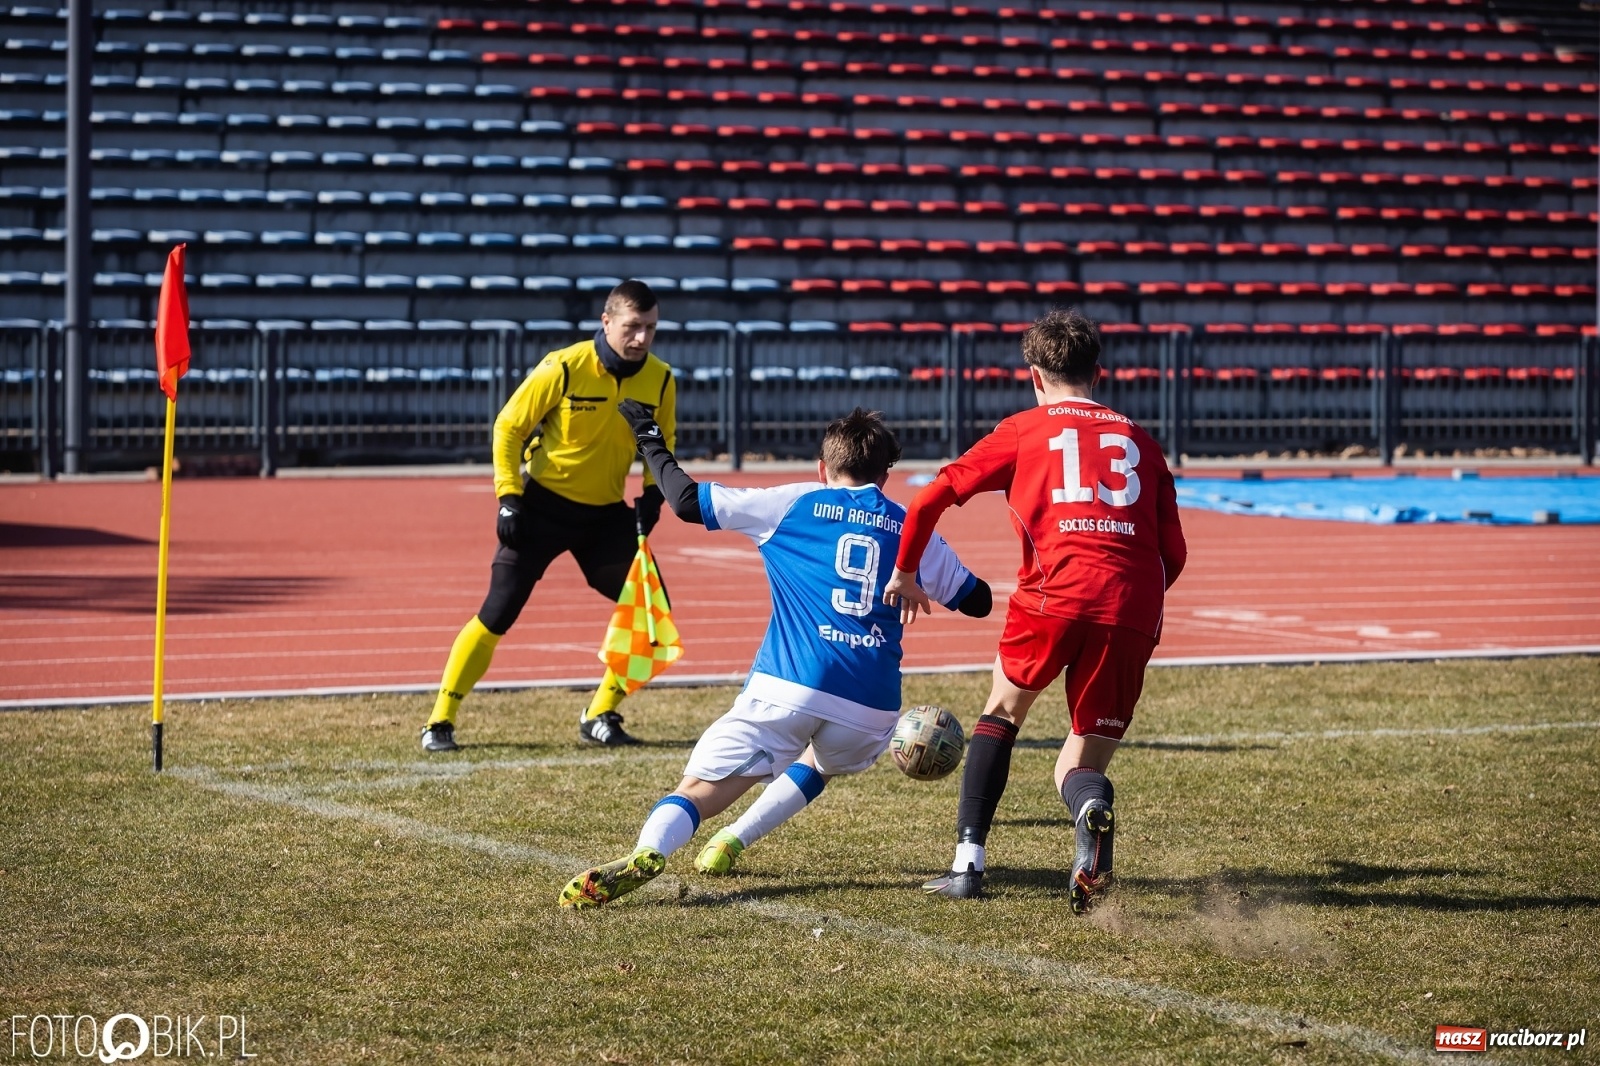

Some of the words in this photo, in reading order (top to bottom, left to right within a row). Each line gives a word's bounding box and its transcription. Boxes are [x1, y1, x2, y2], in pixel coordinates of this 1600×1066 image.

[1047, 405, 1093, 419] GÓRNIK
[1048, 428, 1141, 507] 13
[813, 502, 844, 521] UNIA
[1058, 518, 1096, 533] SOCIOS
[1097, 515, 1135, 536] GÓRNIK
[831, 532, 881, 619] 9
